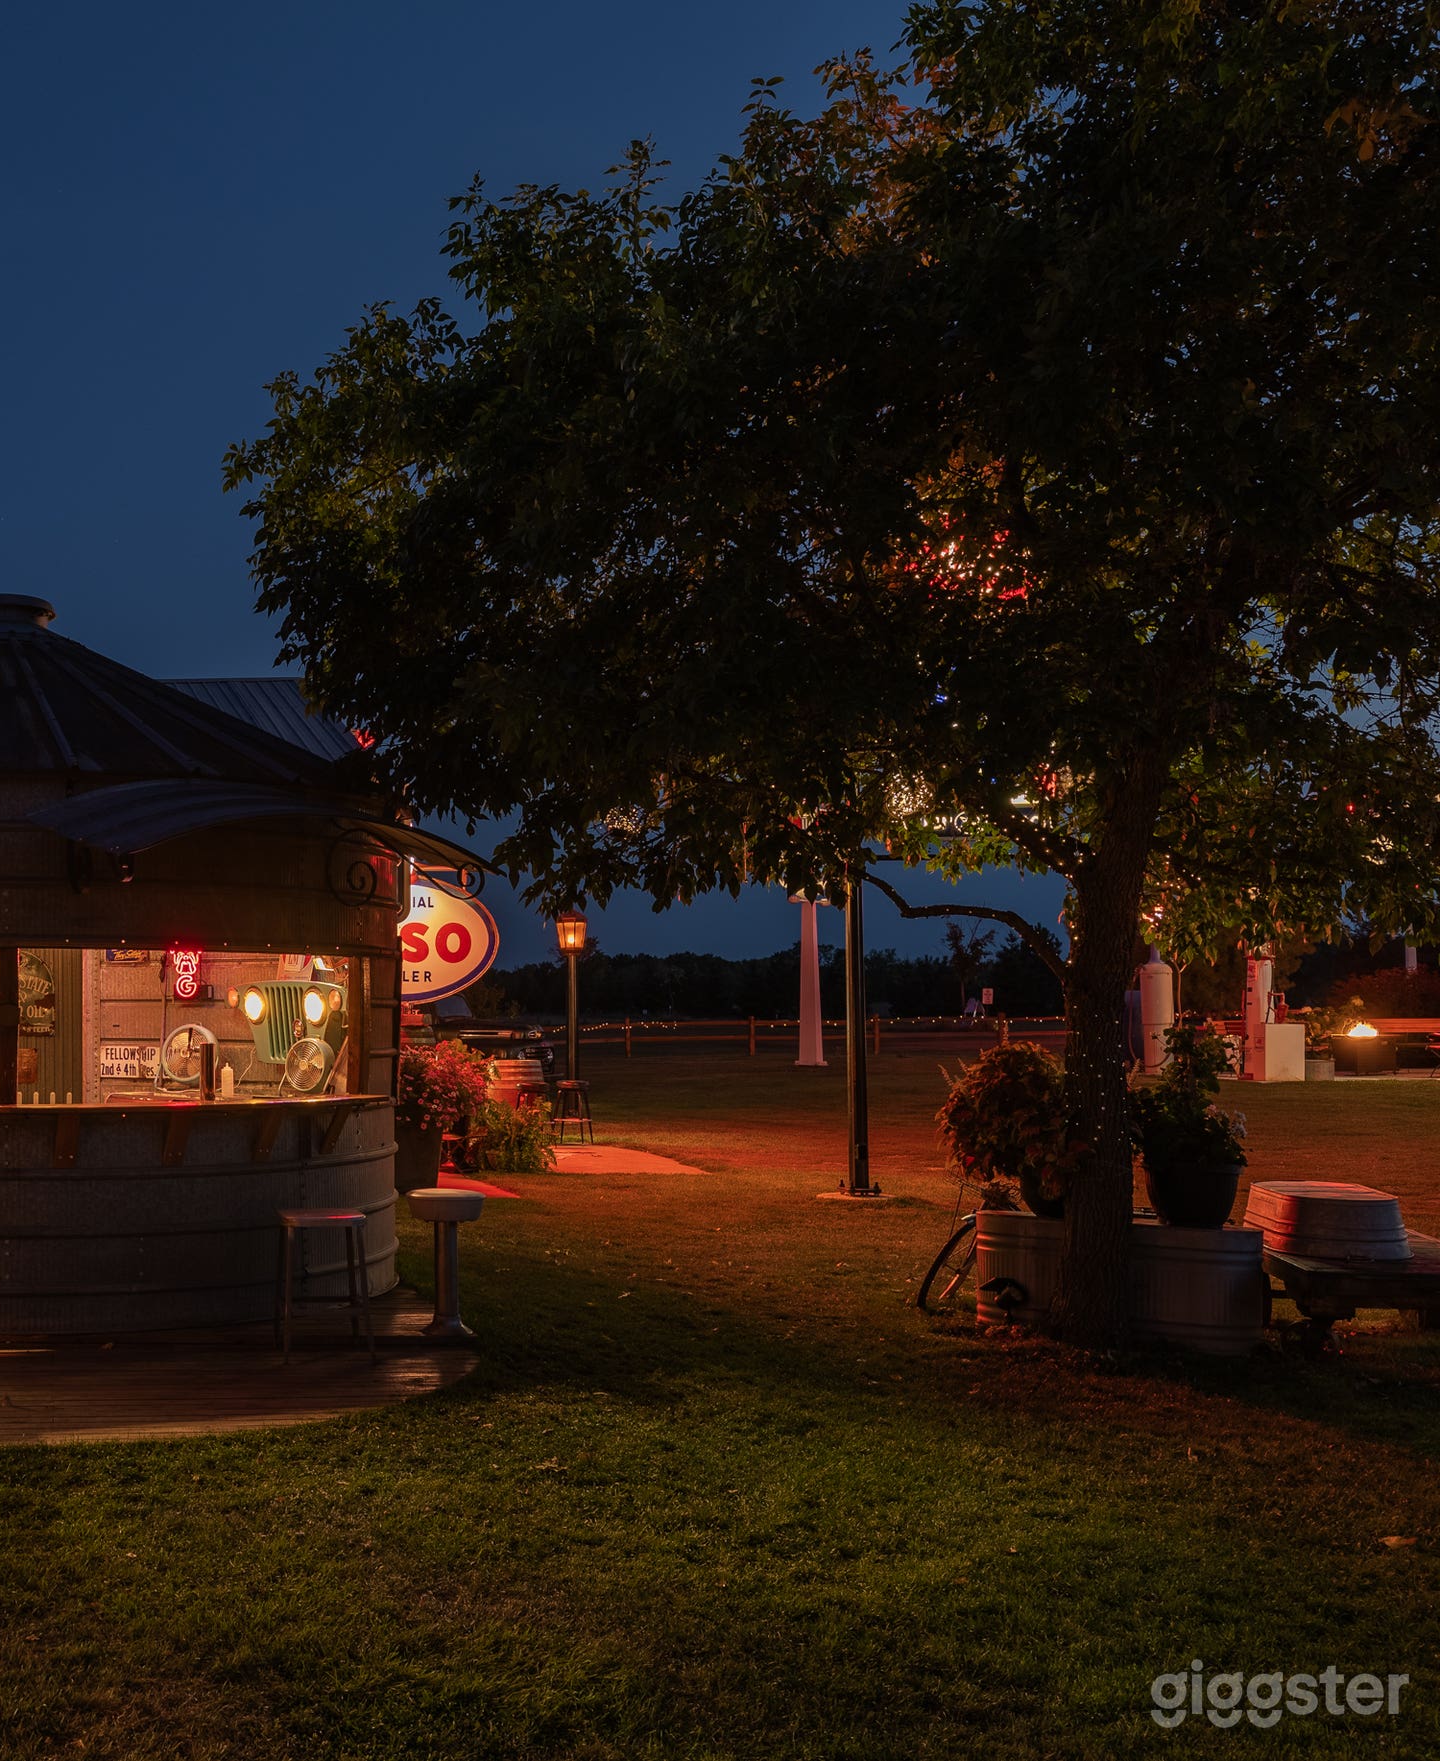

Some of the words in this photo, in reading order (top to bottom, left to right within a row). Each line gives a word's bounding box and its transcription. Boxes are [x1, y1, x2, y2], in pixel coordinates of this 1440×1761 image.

[105, 1047, 157, 1062] FELLOWSHIP
[100, 1062, 114, 1076] 2nd
[123, 1063, 137, 1077] 4th
